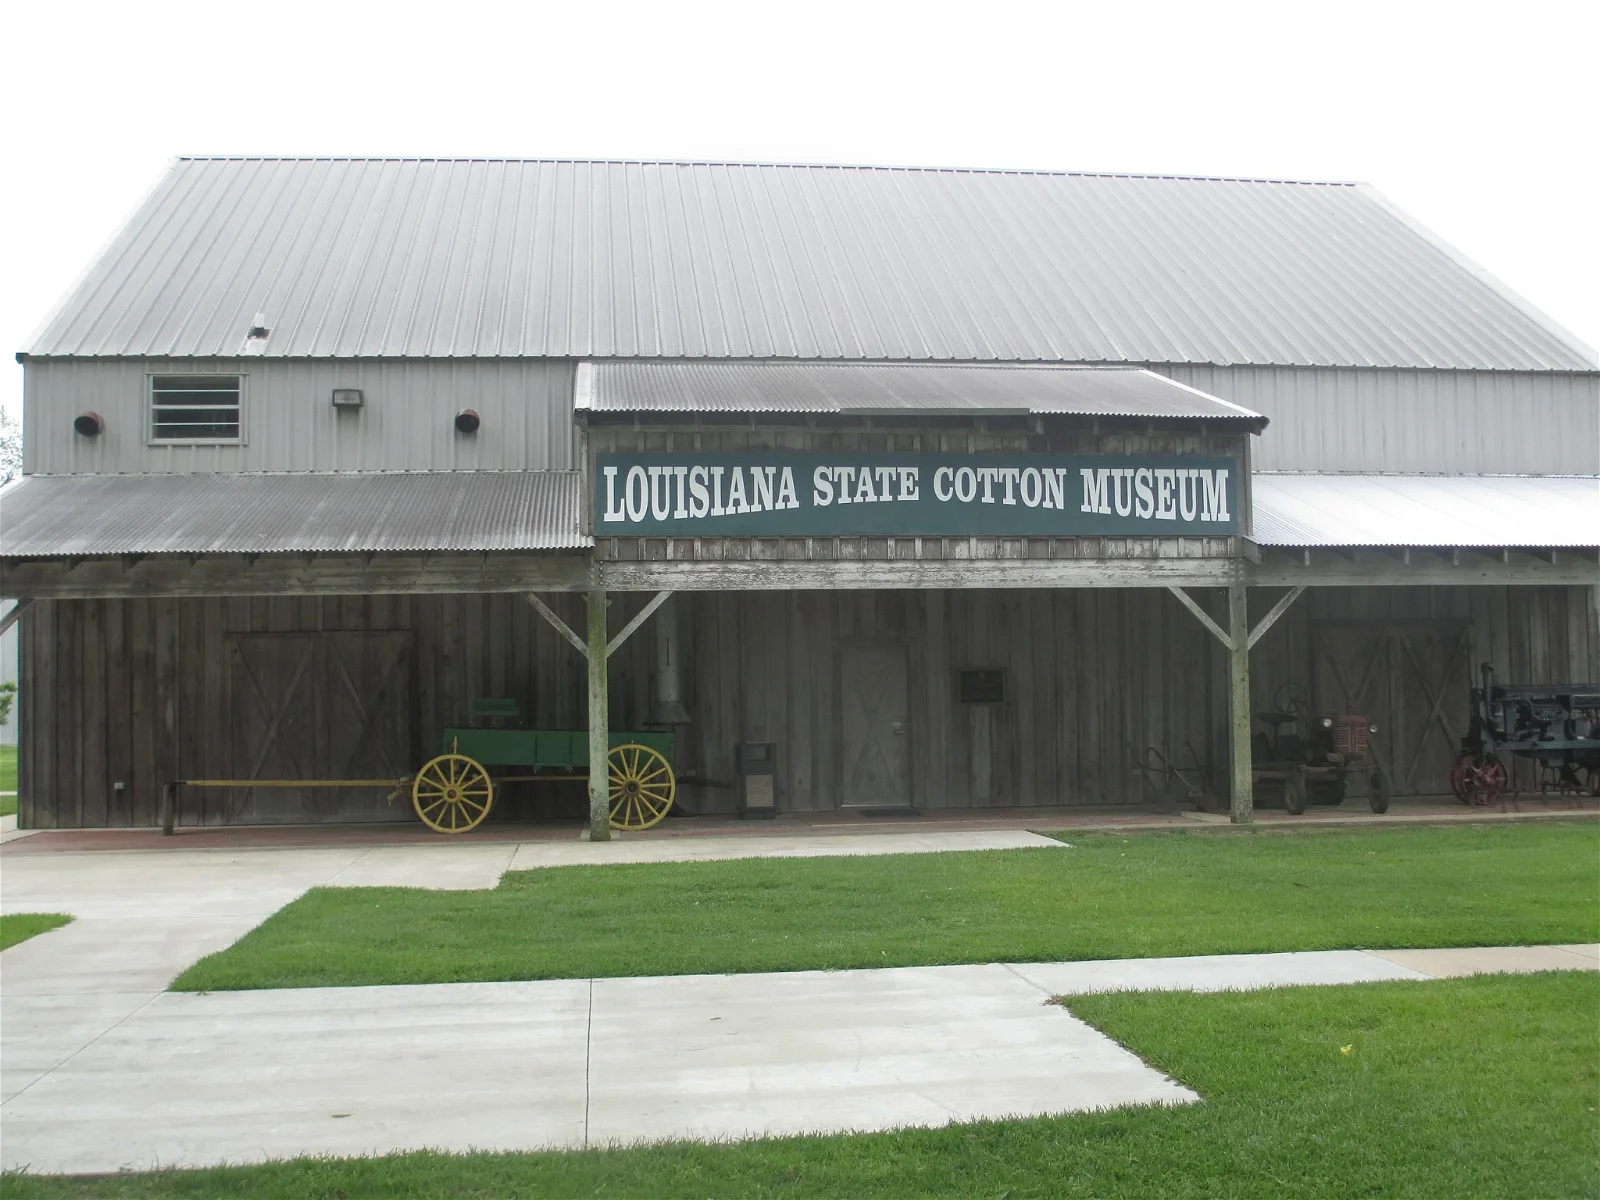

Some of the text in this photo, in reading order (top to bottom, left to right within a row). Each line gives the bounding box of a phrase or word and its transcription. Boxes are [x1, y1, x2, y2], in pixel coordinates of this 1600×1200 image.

[603, 466, 1231, 523] LOUISIANA STATE COTTON MUSEUM
